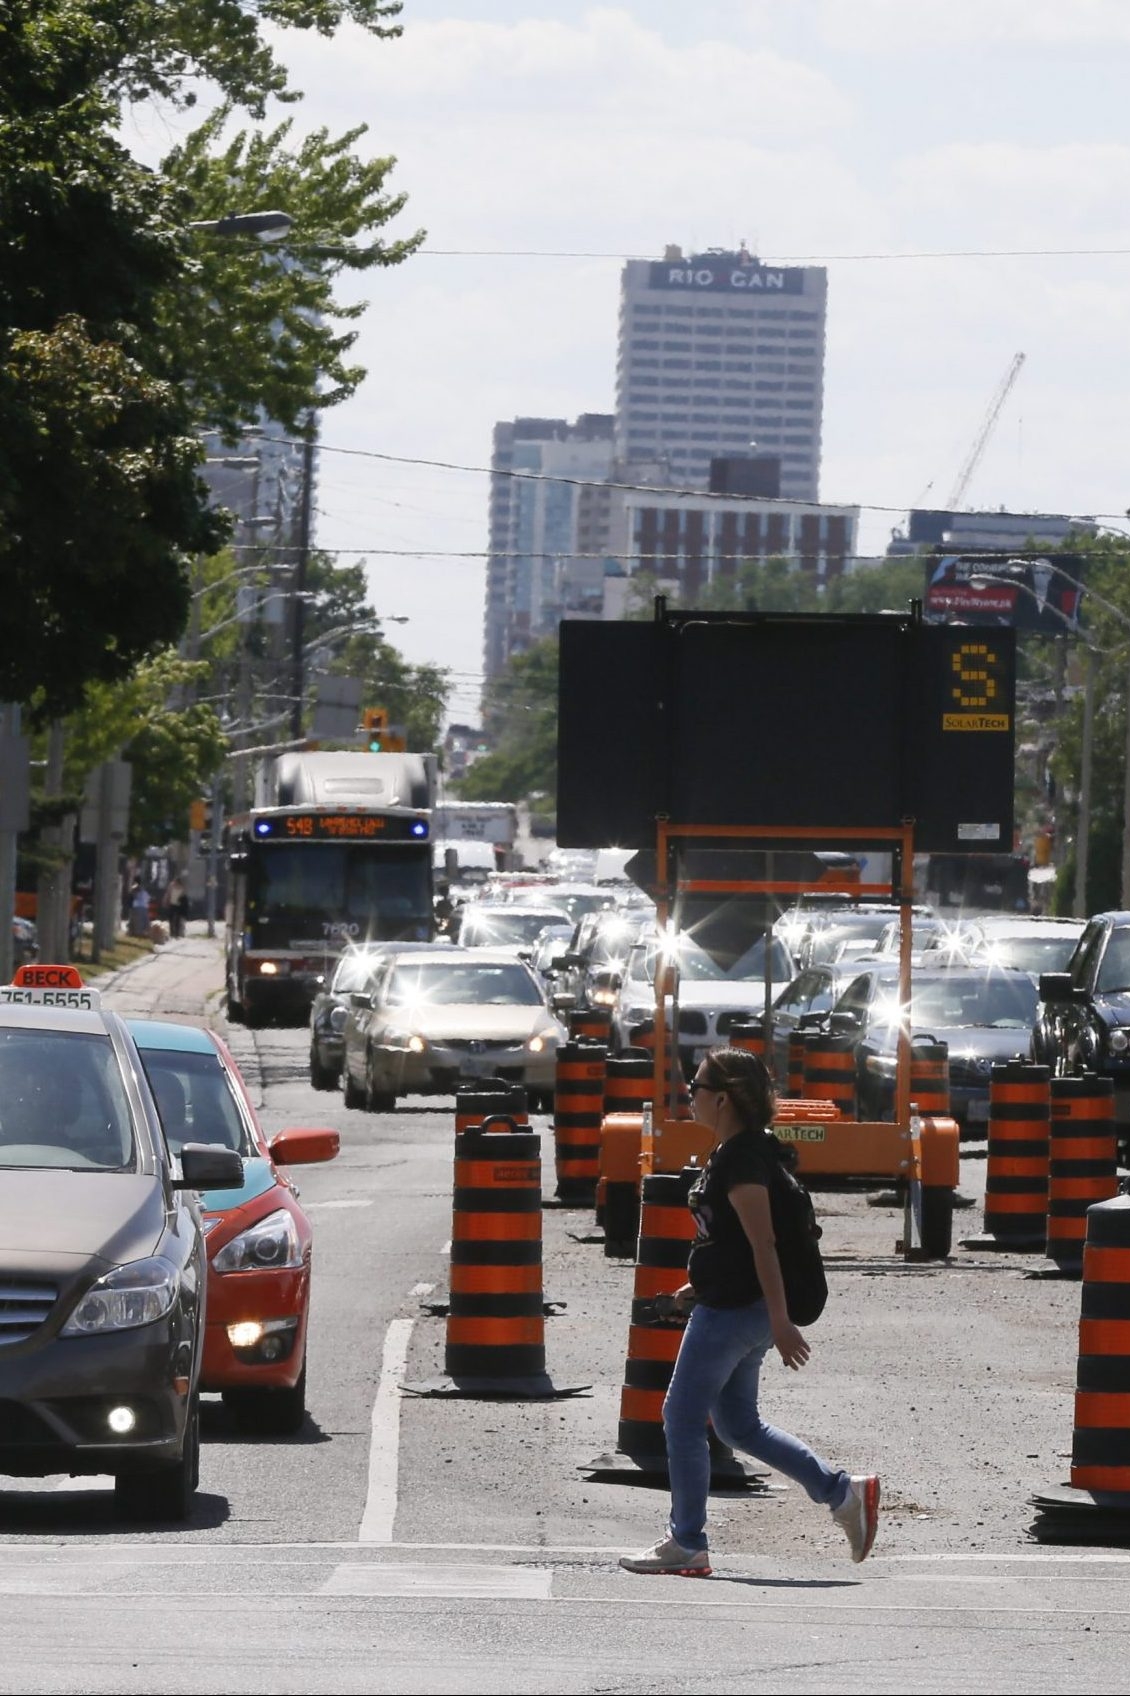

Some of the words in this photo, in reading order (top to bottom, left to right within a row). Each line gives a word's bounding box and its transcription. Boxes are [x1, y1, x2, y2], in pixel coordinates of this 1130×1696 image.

[669, 269, 714, 286] RIO
[730, 271, 784, 289] CAN
[952, 645, 996, 706] S
[23, 969, 73, 987] BECK
[1, 991, 92, 1010] 751-5555
